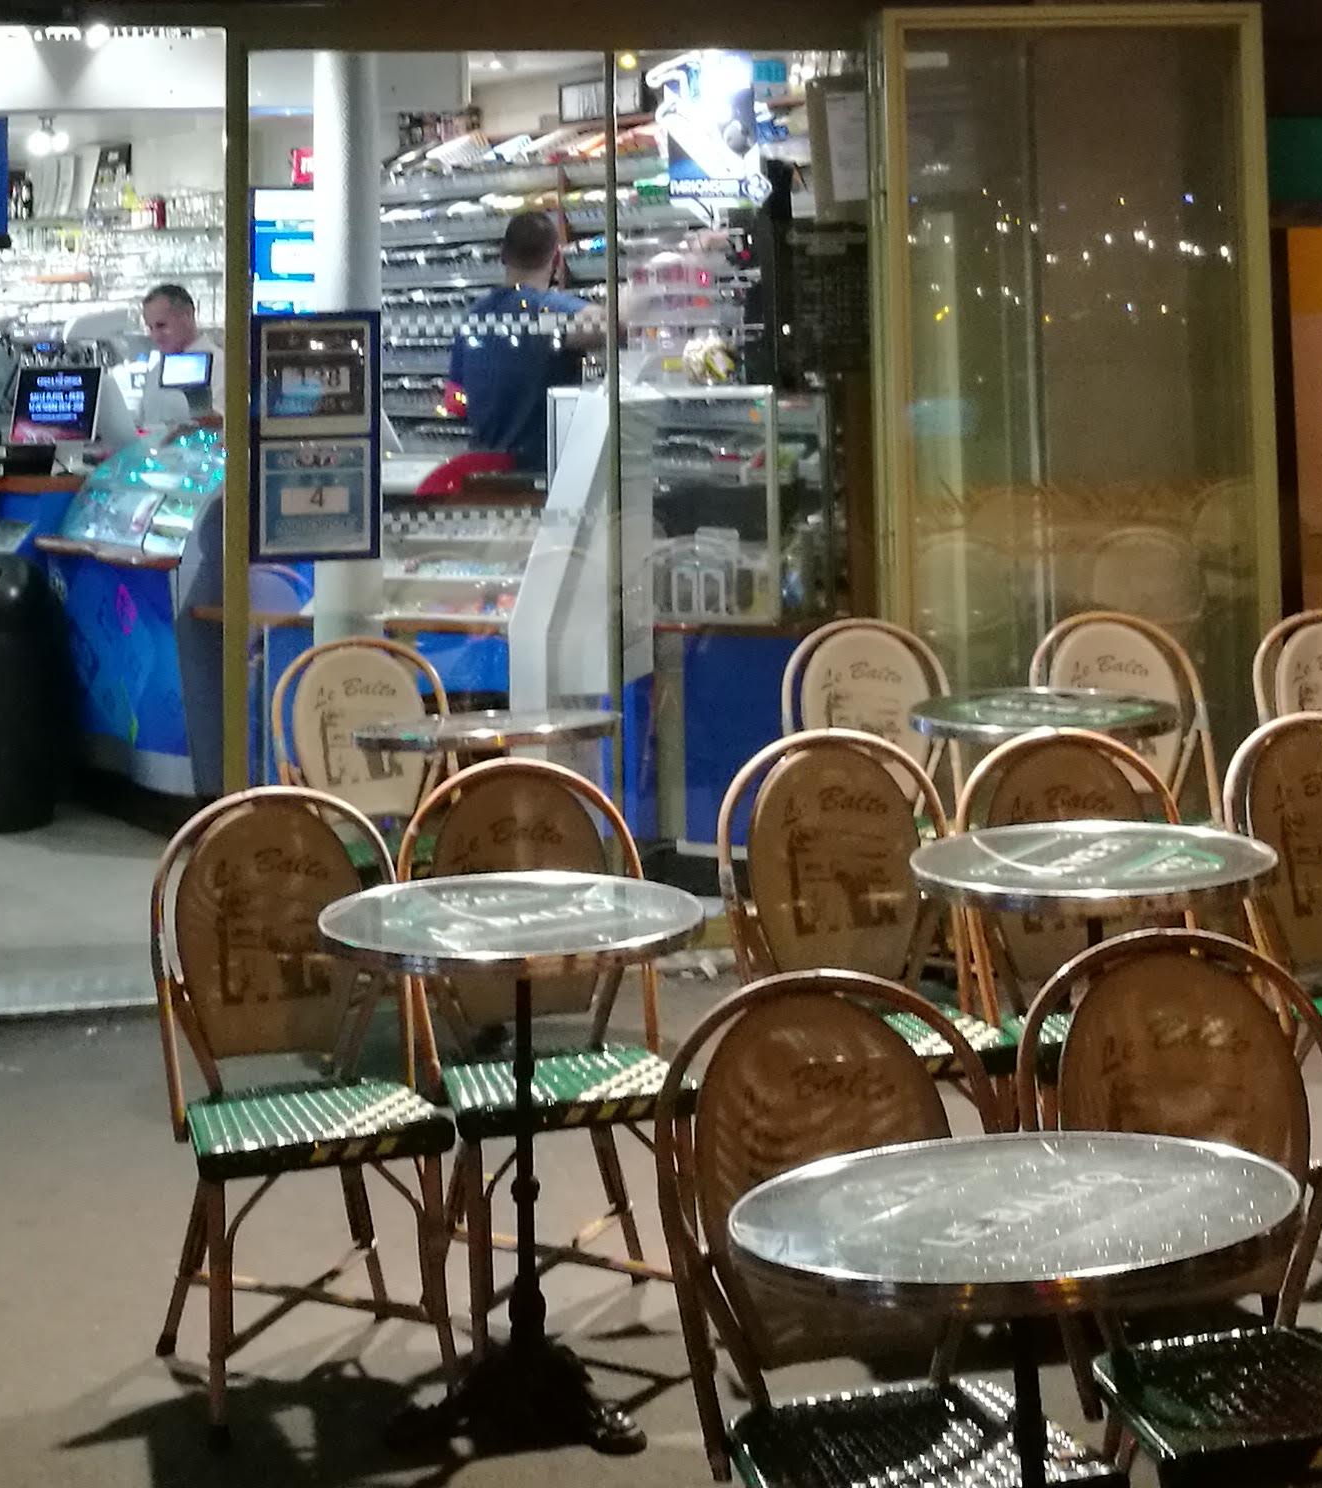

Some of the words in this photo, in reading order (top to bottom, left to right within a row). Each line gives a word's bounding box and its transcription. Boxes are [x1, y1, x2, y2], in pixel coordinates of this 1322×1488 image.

[309, 487, 325, 508] 4
[848, 660, 902, 685] Balto
[1095, 654, 1150, 679] Balto
[342, 676, 398, 698] Balto
[818, 785, 889, 815] Balto
[487, 816, 564, 847] Balto
[253, 846, 330, 882] Balto
